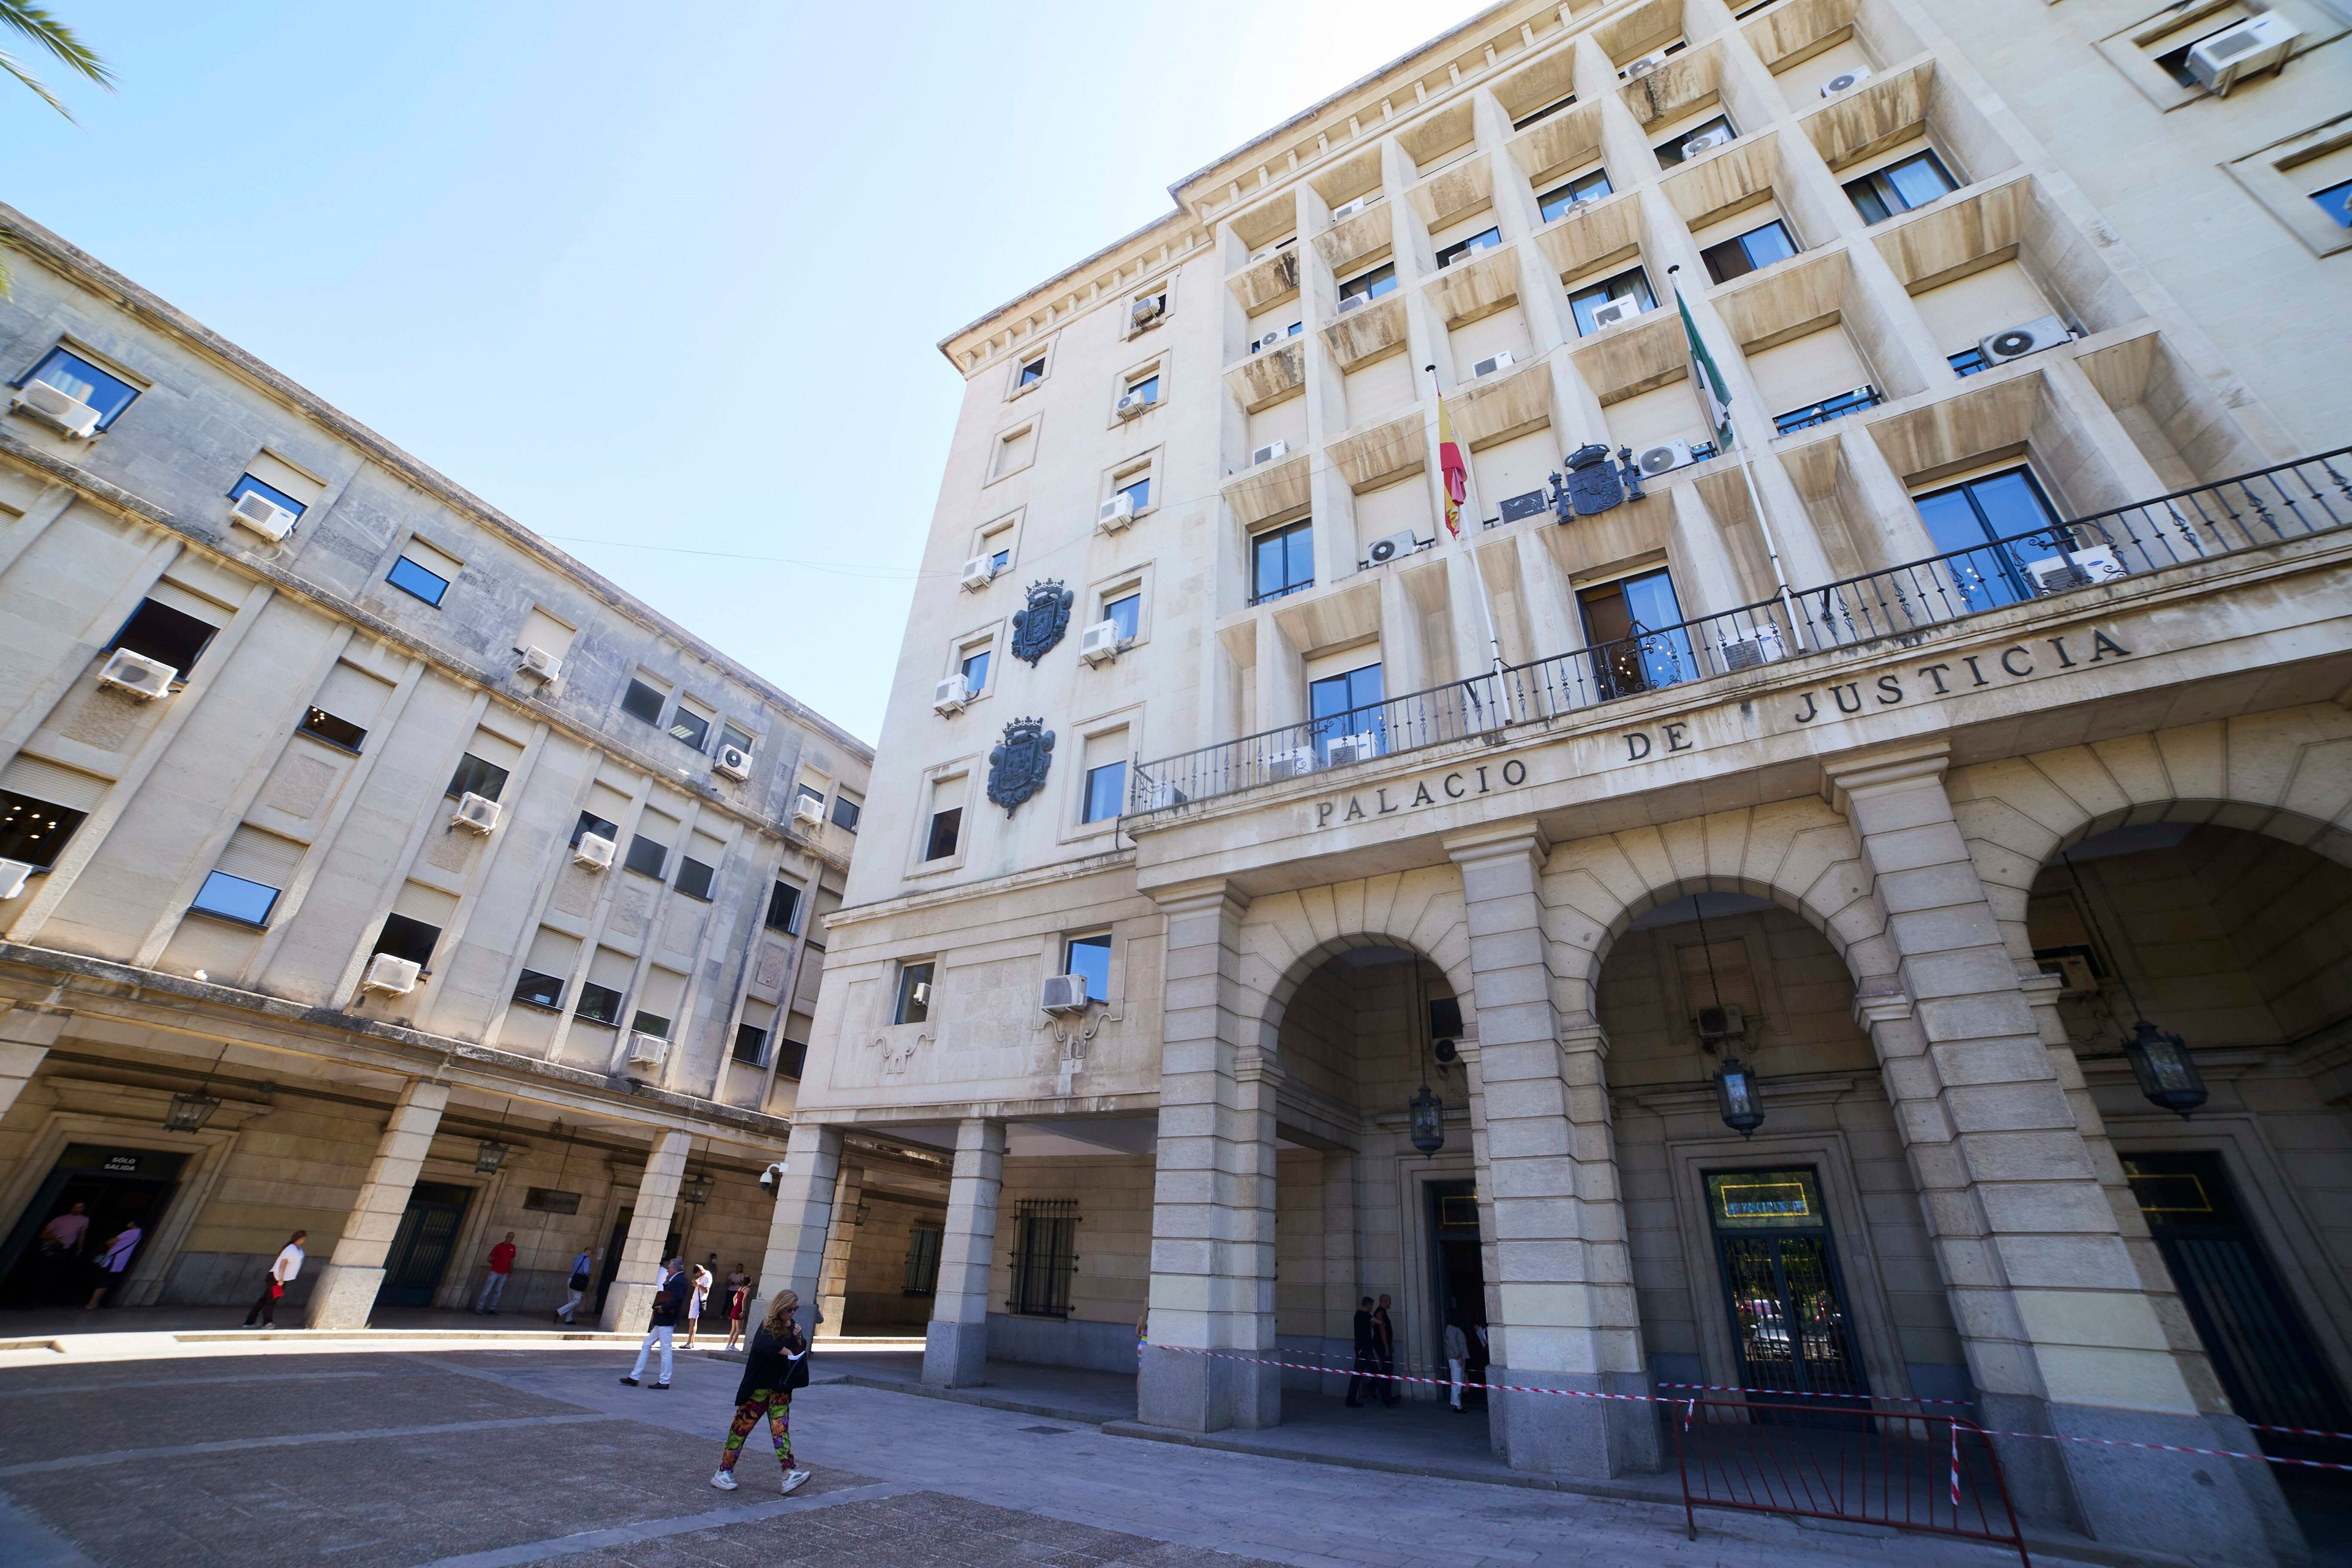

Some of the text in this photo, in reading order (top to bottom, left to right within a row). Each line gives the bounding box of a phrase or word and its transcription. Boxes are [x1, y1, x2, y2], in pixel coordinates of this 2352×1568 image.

[1316, 629, 2132, 827] PALACIO DE JUSTICIA
